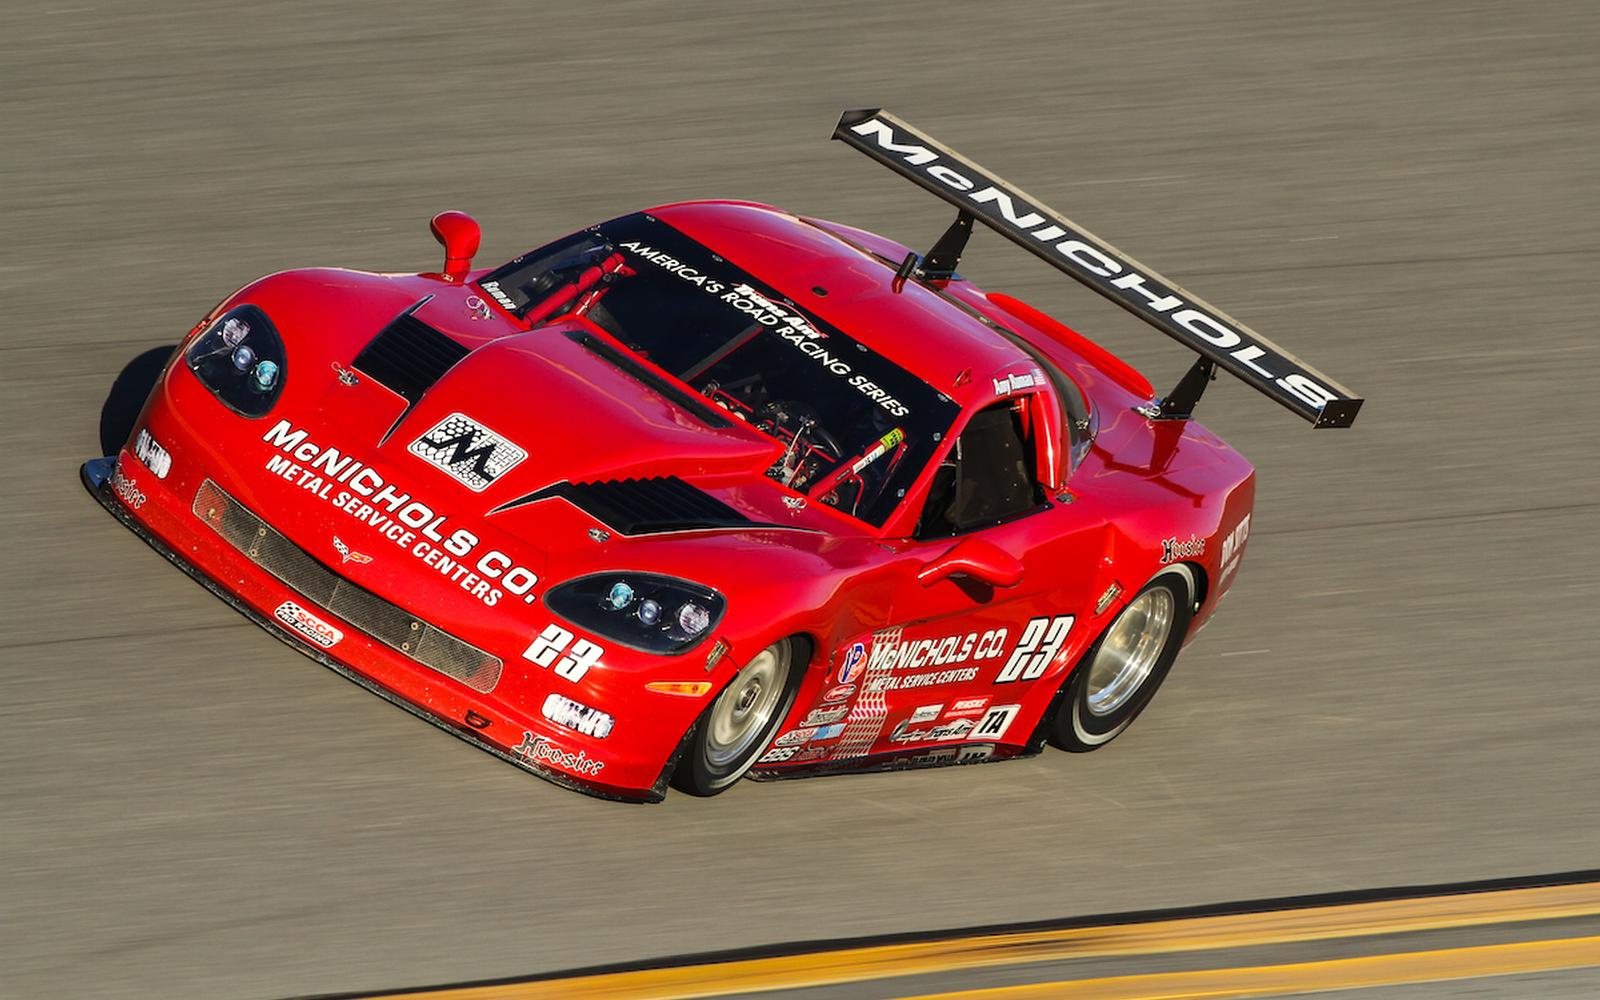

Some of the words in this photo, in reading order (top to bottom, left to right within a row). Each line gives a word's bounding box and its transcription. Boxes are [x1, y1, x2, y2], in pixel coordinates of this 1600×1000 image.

[851, 117, 1339, 409] McNICHOLS
[620, 241, 725, 293] AMERICA'S
[721, 292, 778, 326] ROAD
[776, 326, 851, 376] RACING
[848, 375, 910, 418] SERIES
[733, 282, 788, 320] Trans
[782, 314, 821, 340] Am
[262, 419, 480, 557] McNICHOLS
[476, 551, 540, 605] CO.
[265, 455, 330, 500] METAL
[332, 490, 417, 549] SERVICE
[412, 540, 504, 607] CENTERS
[277, 610, 298, 628] PRO
[295, 623, 332, 646] RACING
[296, 611, 335, 640] SCCA
[521, 623, 605, 684] 23
[867, 635, 976, 671] McNICHOLS
[973, 628, 1008, 660] CO.
[993, 614, 1076, 685] 23
[870, 676, 901, 692] METAL
[899, 672, 941, 689] SERVICE
[936, 667, 980, 685] CENTERS
[978, 710, 1009, 734] TA
[512, 731, 605, 776] Hoosier
